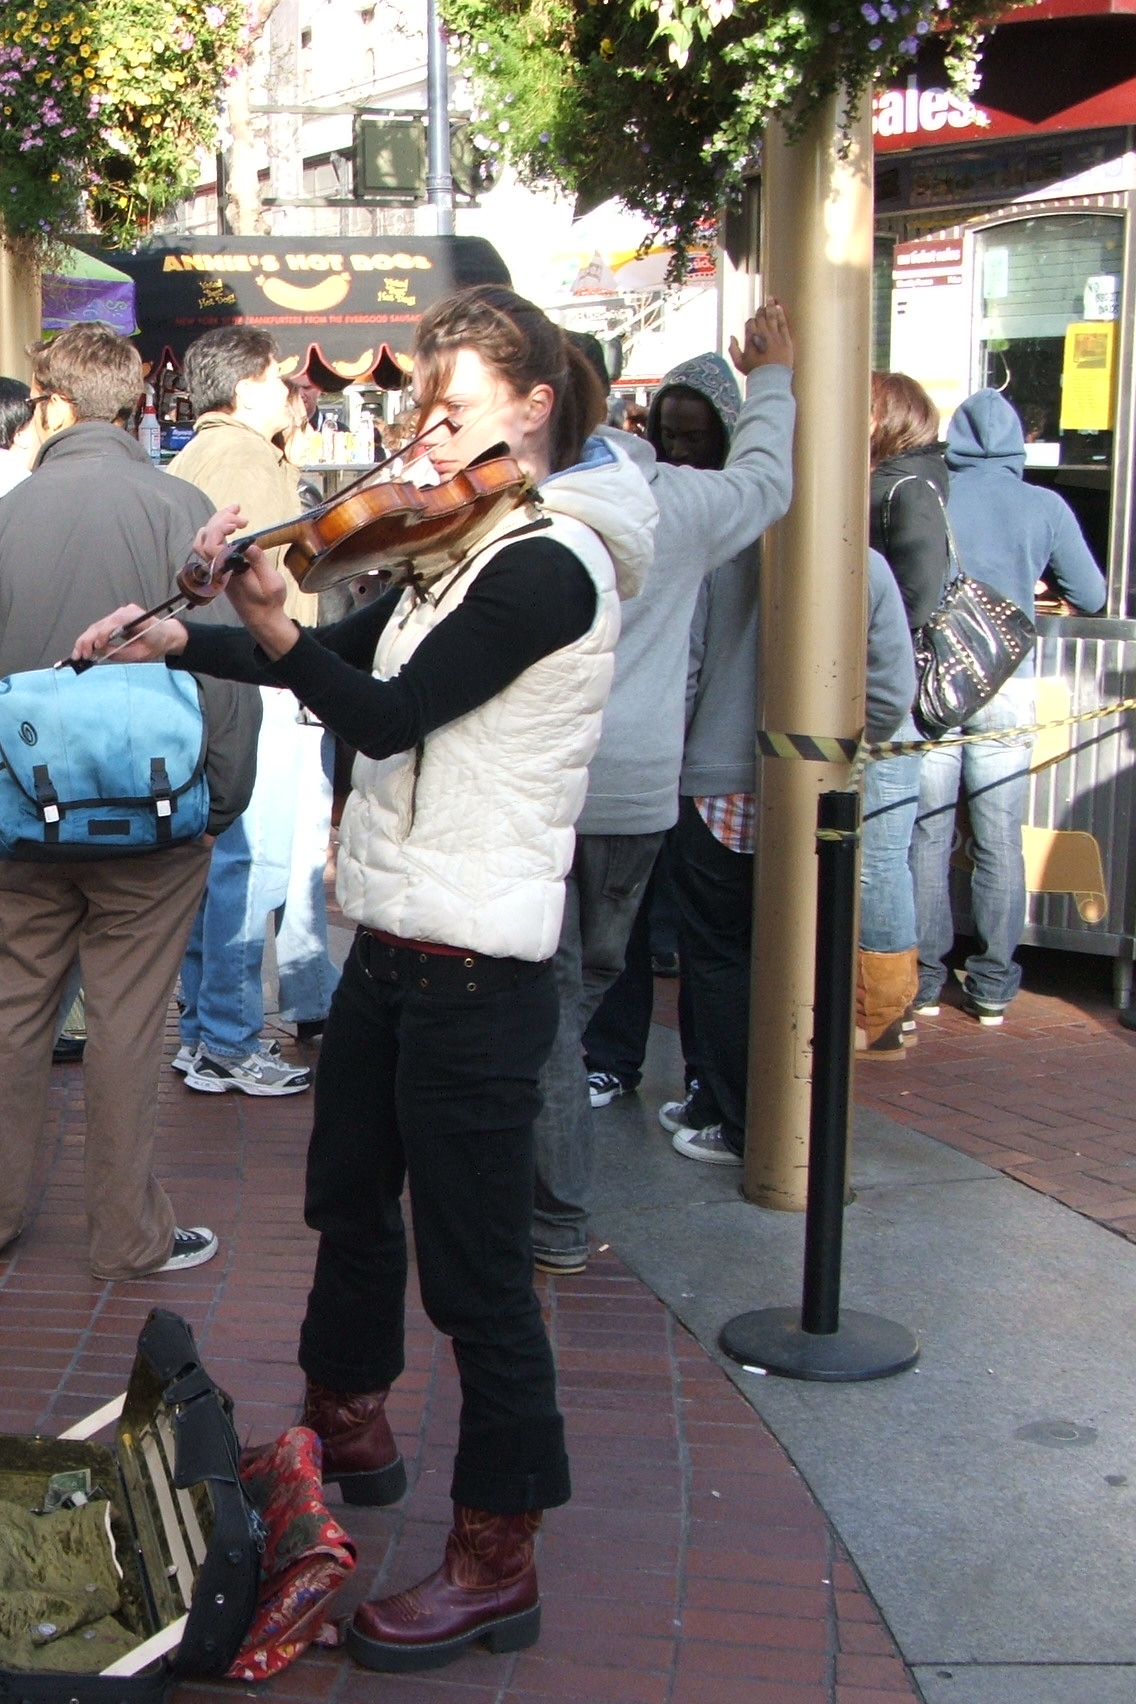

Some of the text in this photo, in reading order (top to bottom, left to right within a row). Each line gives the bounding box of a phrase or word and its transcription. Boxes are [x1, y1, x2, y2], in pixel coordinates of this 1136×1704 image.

[872, 74, 977, 136] ales
[162, 252, 432, 272] ANNIE'S HOT DOGS
